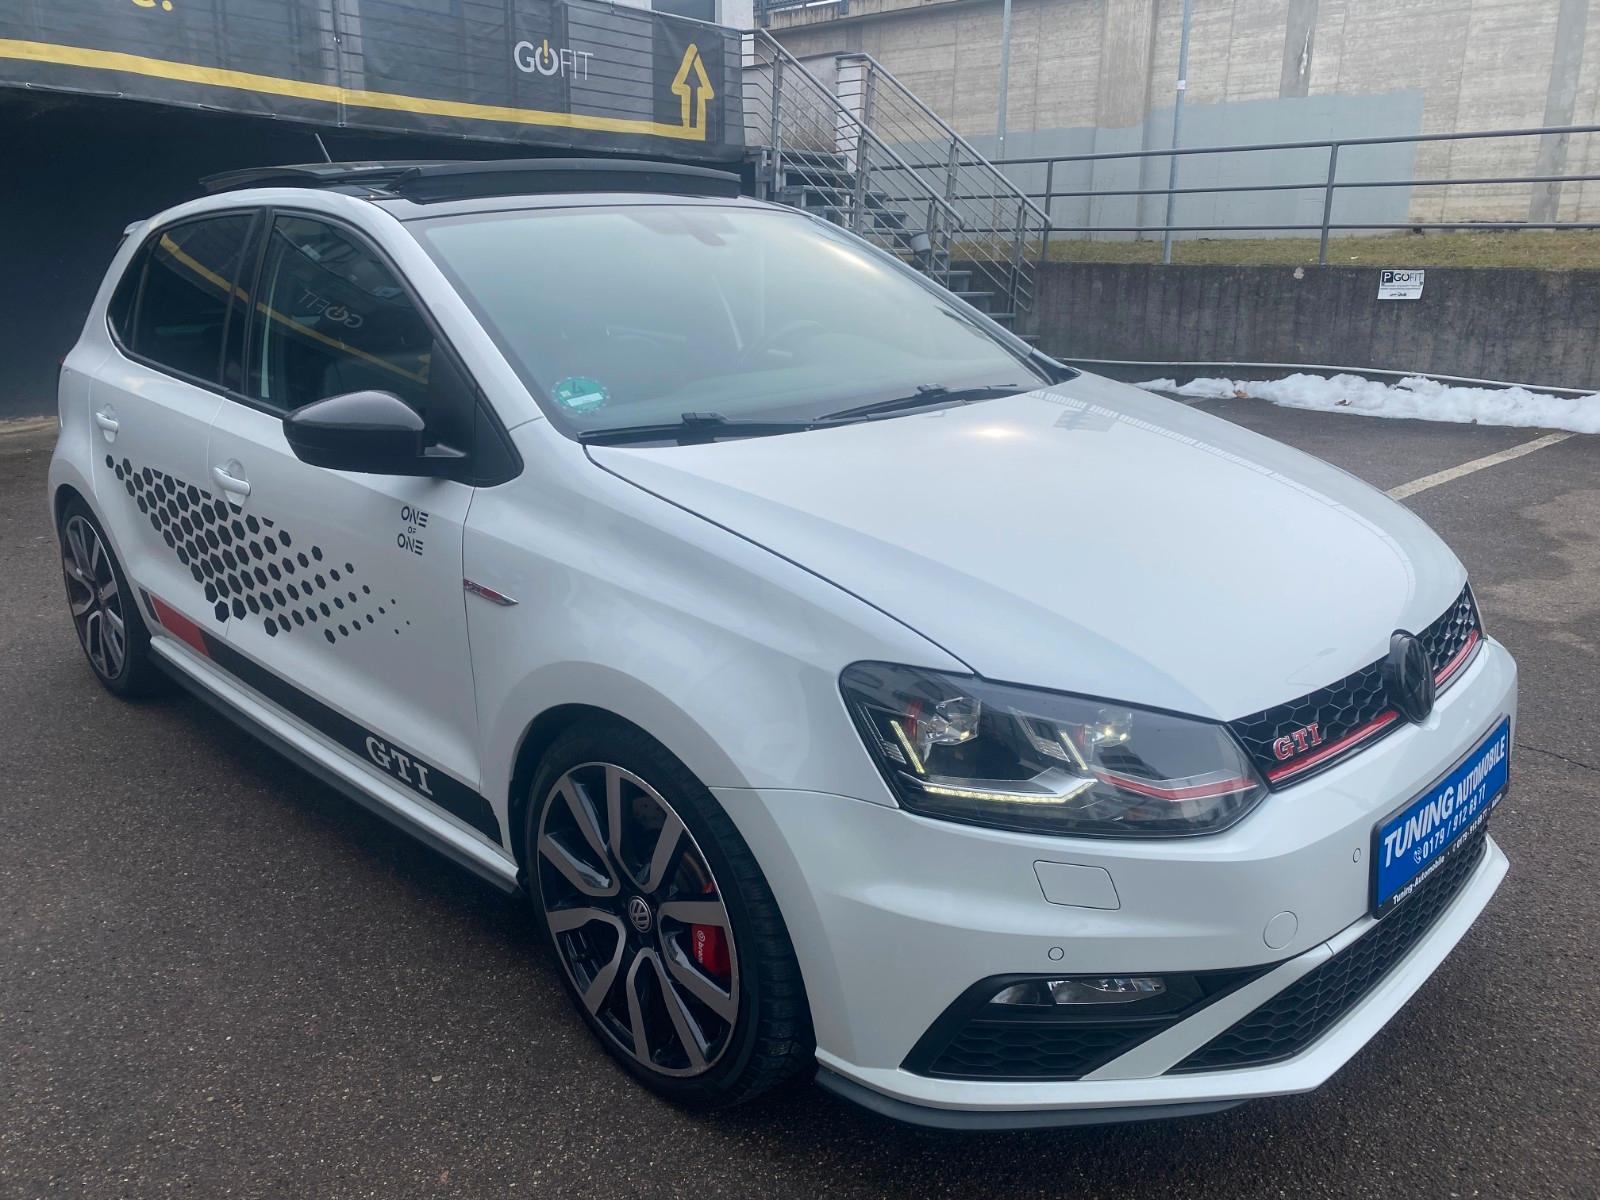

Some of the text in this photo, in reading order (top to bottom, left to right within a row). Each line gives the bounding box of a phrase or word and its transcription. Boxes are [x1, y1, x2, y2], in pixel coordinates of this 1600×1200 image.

[513, 39, 594, 80] GOFIT
[401, 505, 429, 528] ONE
[397, 533, 424, 556] ONE
[1272, 722, 1322, 760] GTI
[366, 736, 433, 796] GTI
[1384, 734, 1506, 868] TUNING AUTOMOBILE
[1423, 827, 1445, 859] 0179
[1453, 805, 1468, 831] 912
